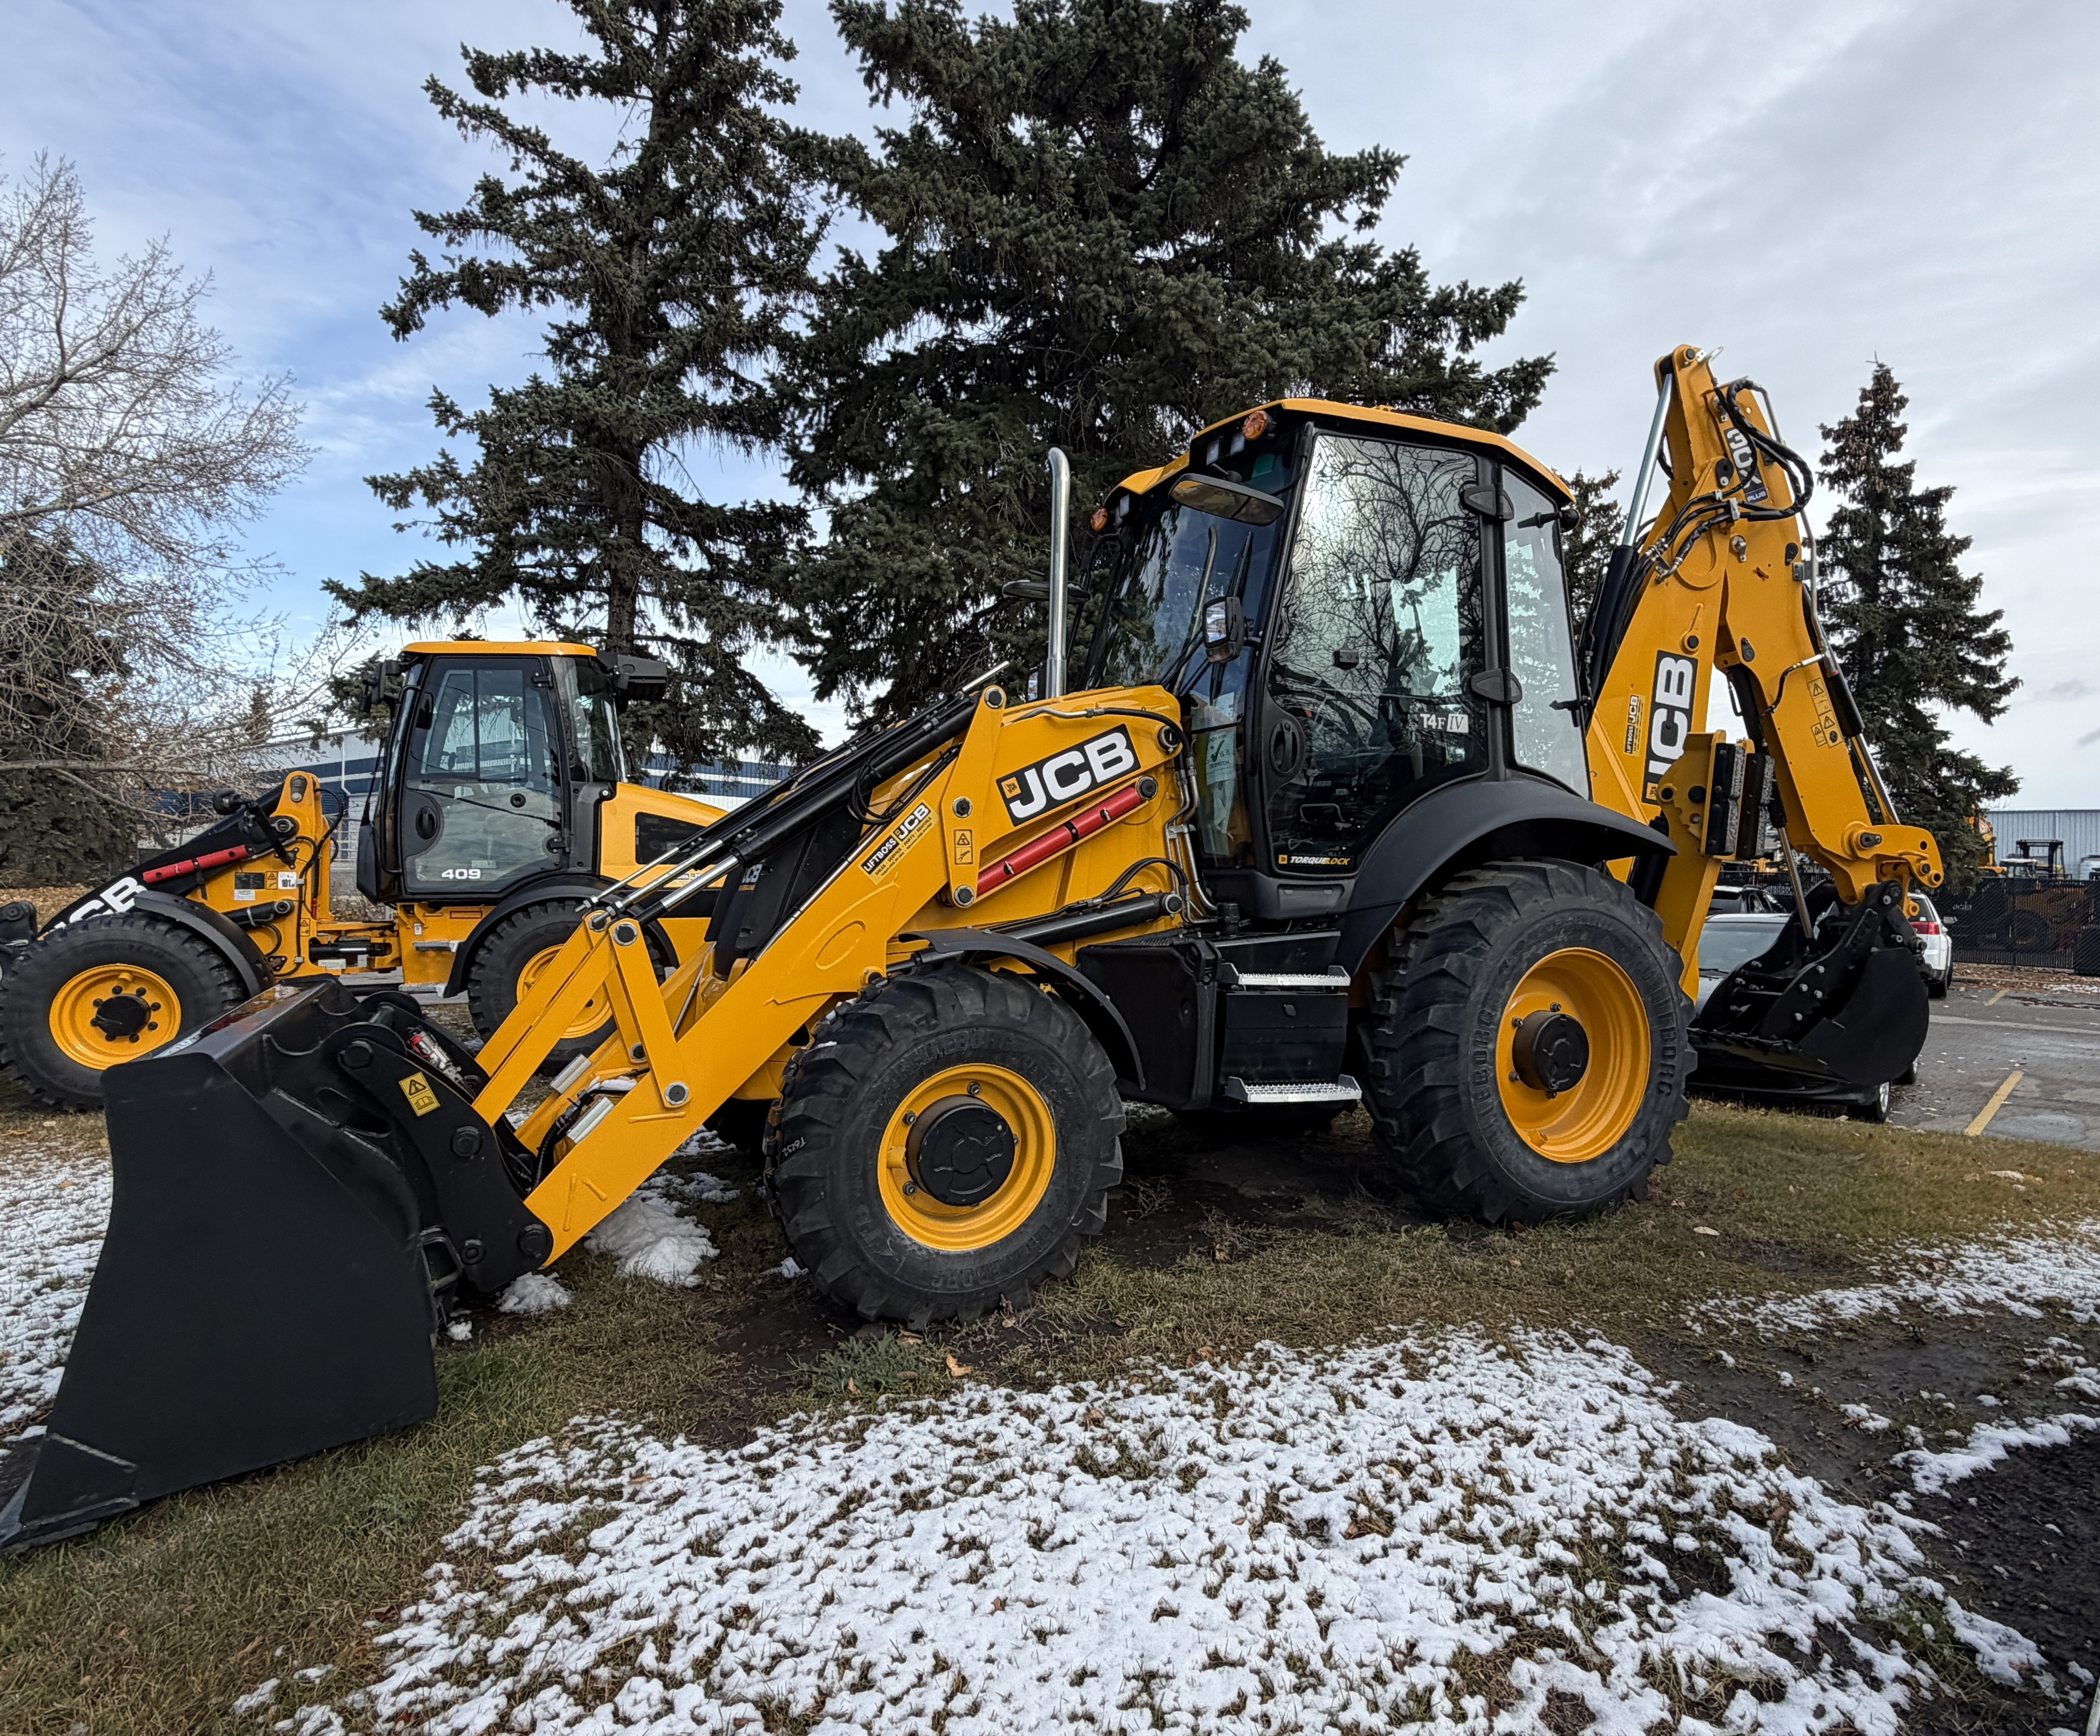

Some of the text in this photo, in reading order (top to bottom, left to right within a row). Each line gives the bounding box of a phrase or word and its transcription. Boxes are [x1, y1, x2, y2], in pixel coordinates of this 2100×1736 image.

[1747, 491, 1766, 502] PLUS
[1629, 695, 1638, 723] JCB
[1009, 732, 1134, 819] JCB
[863, 838, 897, 872] LIFTBOSS
[898, 804, 929, 840] JCB
[875, 864, 887, 876] SALES
[1290, 856, 1350, 865] TORQUELOCK
[442, 868, 481, 880] 409
[49, 876, 148, 933] CB
